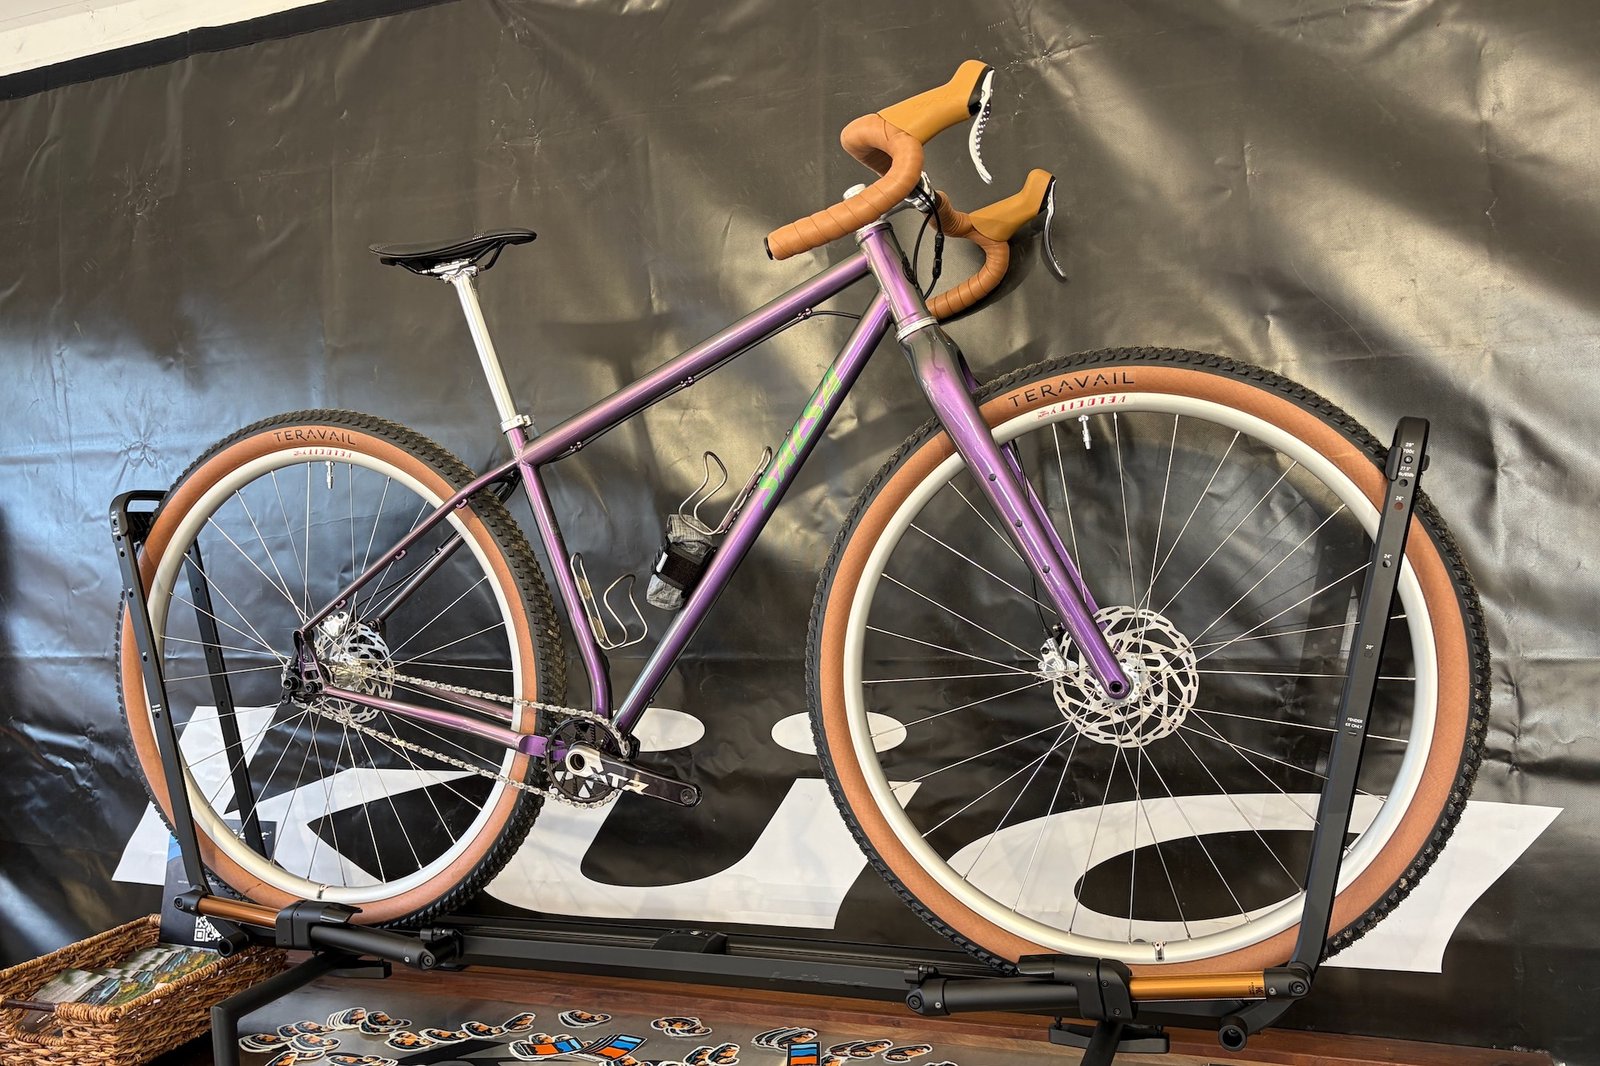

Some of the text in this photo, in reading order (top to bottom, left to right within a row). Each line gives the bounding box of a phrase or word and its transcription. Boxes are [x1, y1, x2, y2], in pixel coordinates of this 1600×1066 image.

[1008, 371, 1135, 407] TERAVAIL
[1050, 395, 1127, 415] VELOCITY
[273, 429, 356, 446] TERAVAIL
[758, 364, 842, 510] SALSA
